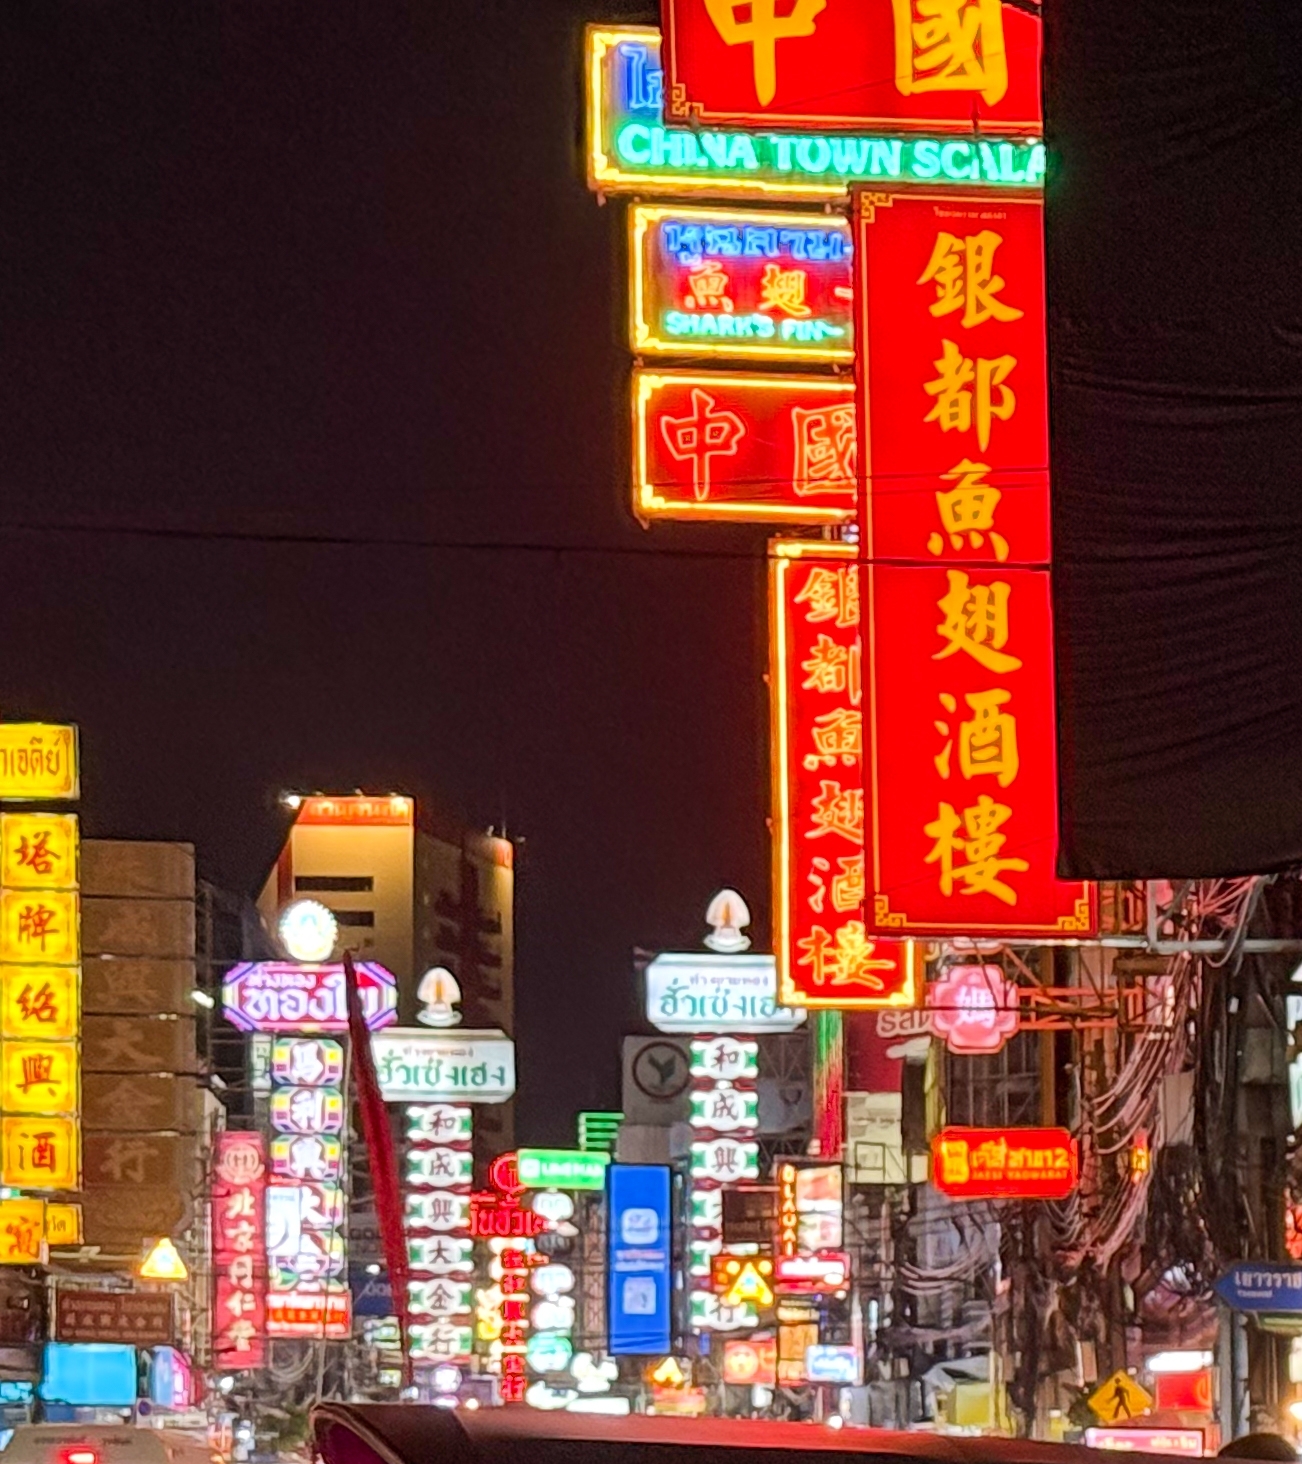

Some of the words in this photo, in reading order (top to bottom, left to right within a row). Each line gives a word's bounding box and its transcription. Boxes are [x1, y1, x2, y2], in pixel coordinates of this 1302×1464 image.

[617, 124, 761, 170] CHINA
[772, 136, 902, 176] TOWN
[916, 229, 1032, 906] 銀都魚翅酒樓
